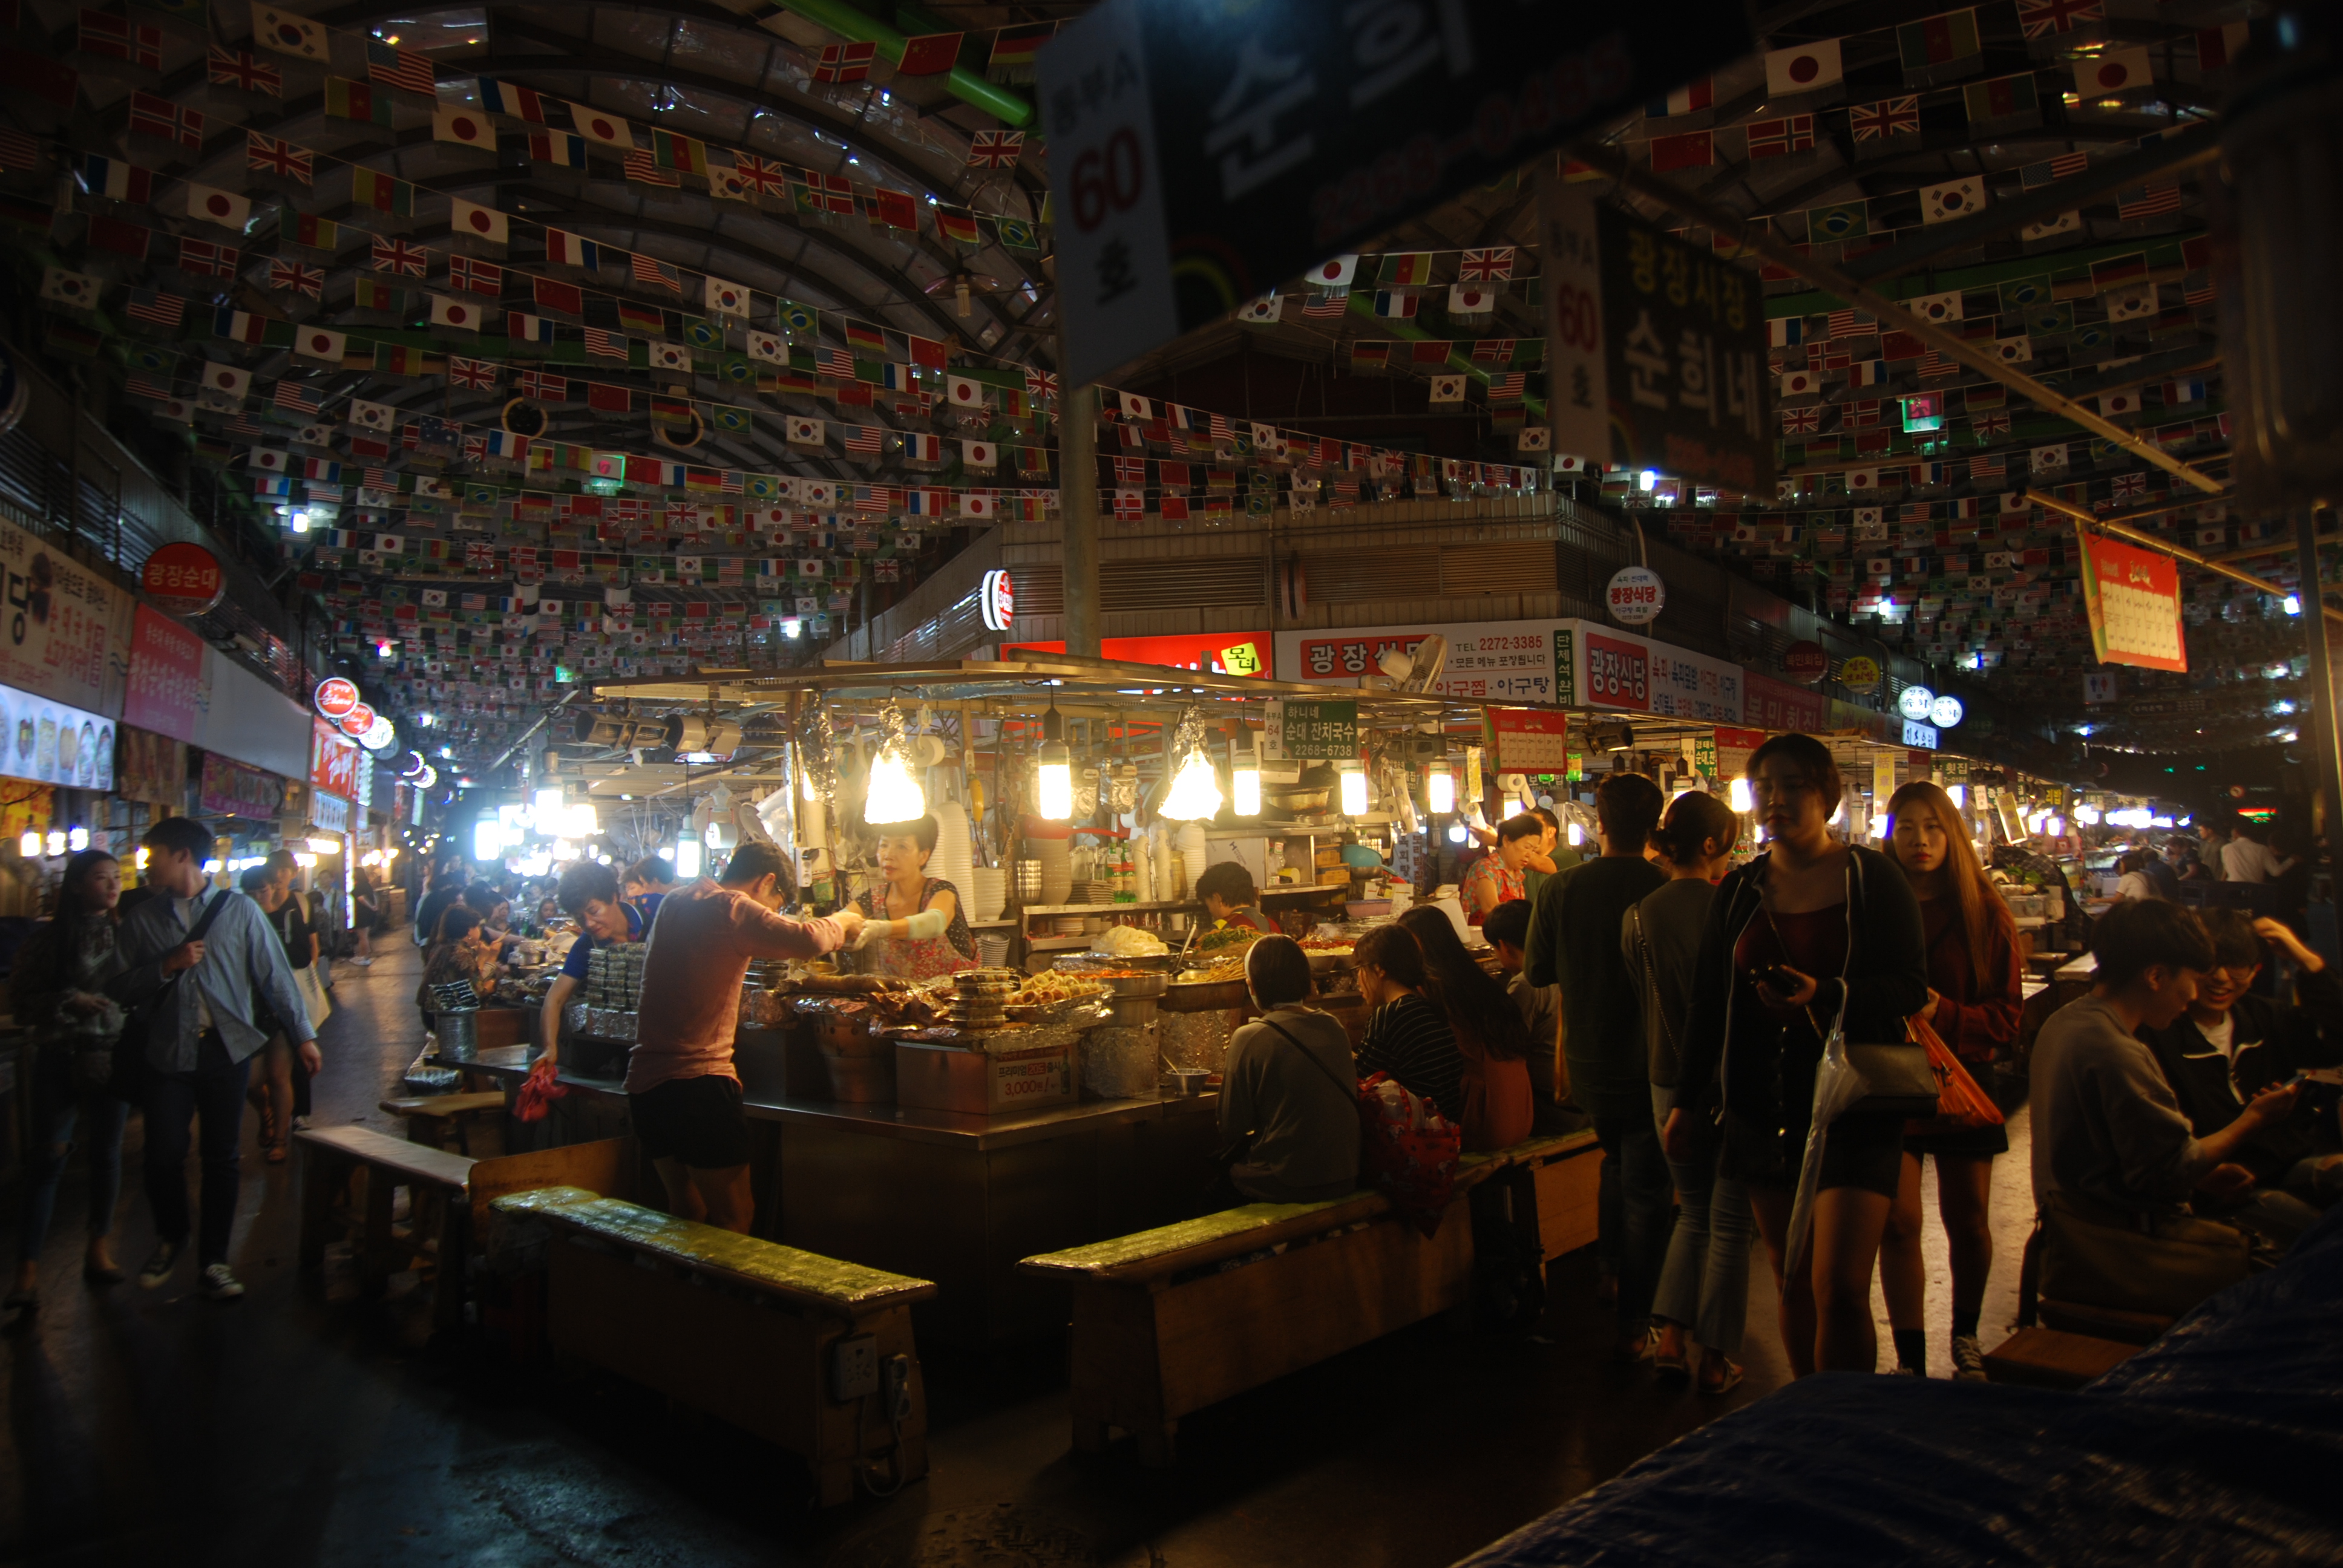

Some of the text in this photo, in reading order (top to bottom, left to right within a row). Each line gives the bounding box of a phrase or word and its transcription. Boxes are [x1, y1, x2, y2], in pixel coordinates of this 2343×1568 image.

[1203, 0, 1476, 203] 순희
[1070, 126, 1144, 235] 60
[1096, 236, 1138, 305] 호
[1558, 282, 1596, 356] 60
[1624, 307, 1761, 441] 순희네
[149, 564, 218, 590] 광장순대
[1610, 586, 1656, 604] 광장식당
[1455, 635, 1542, 652] TEL 2272-3385
[1456, 654, 1545, 668] 모든 메뉴 포장됩니다
[1556, 635, 1572, 705] 단체석완비
[1590, 647, 1646, 701] 광장식당
[1435, 677, 1550, 696] 아구찜 아구탕
[1265, 712, 1282, 720] 동부A
[1288, 705, 1319, 719] 하니네
[1267, 725, 1280, 736] 64
[1285, 722, 1354, 742] 순대 잔치국수
[1268, 740, 1277, 750] 호
[1295, 744, 1352, 756] 2268-6738
[998, 1065, 1027, 1077] 프리미엄
[1028, 1063, 1046, 1075] 20도
